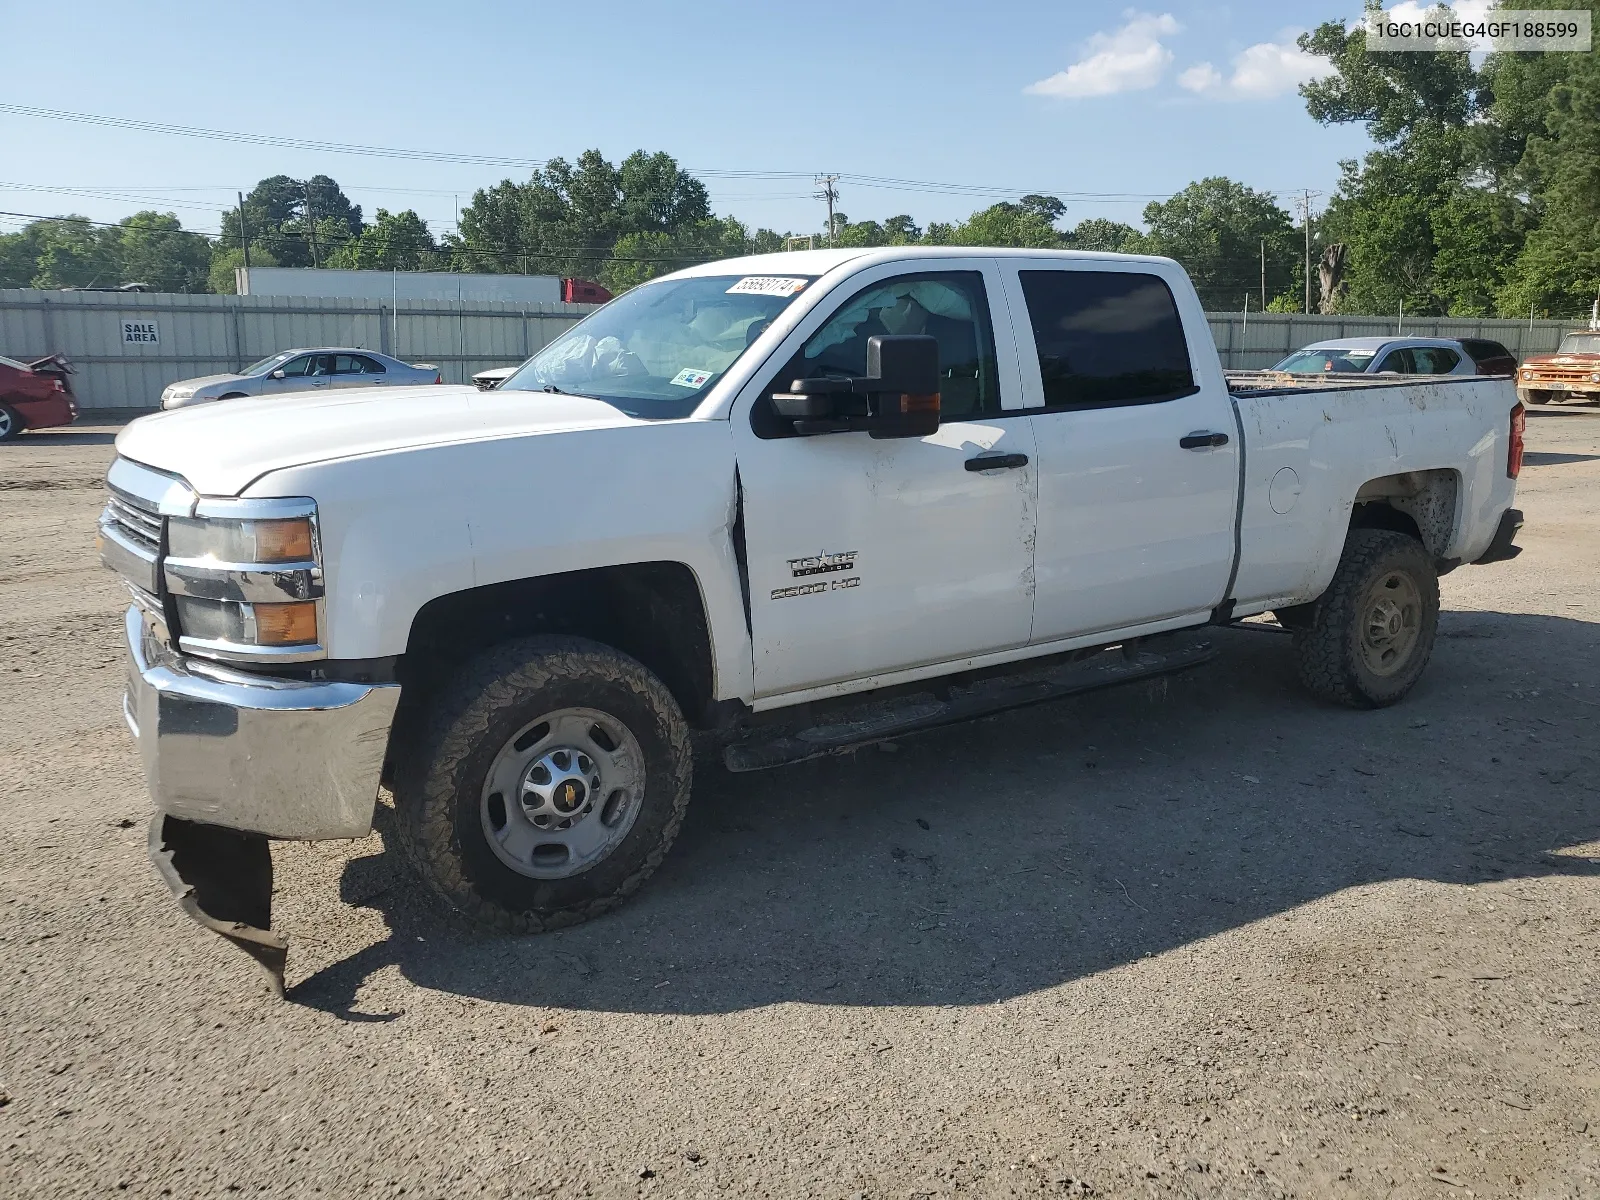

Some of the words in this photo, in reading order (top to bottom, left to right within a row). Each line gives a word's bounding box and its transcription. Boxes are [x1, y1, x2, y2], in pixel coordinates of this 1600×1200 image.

[124, 324, 155, 333] SALE
[125, 333, 157, 342] AREA
[793, 562, 854, 577] EDITION
[771, 581, 828, 600] 2500
[832, 577, 861, 590] HD
